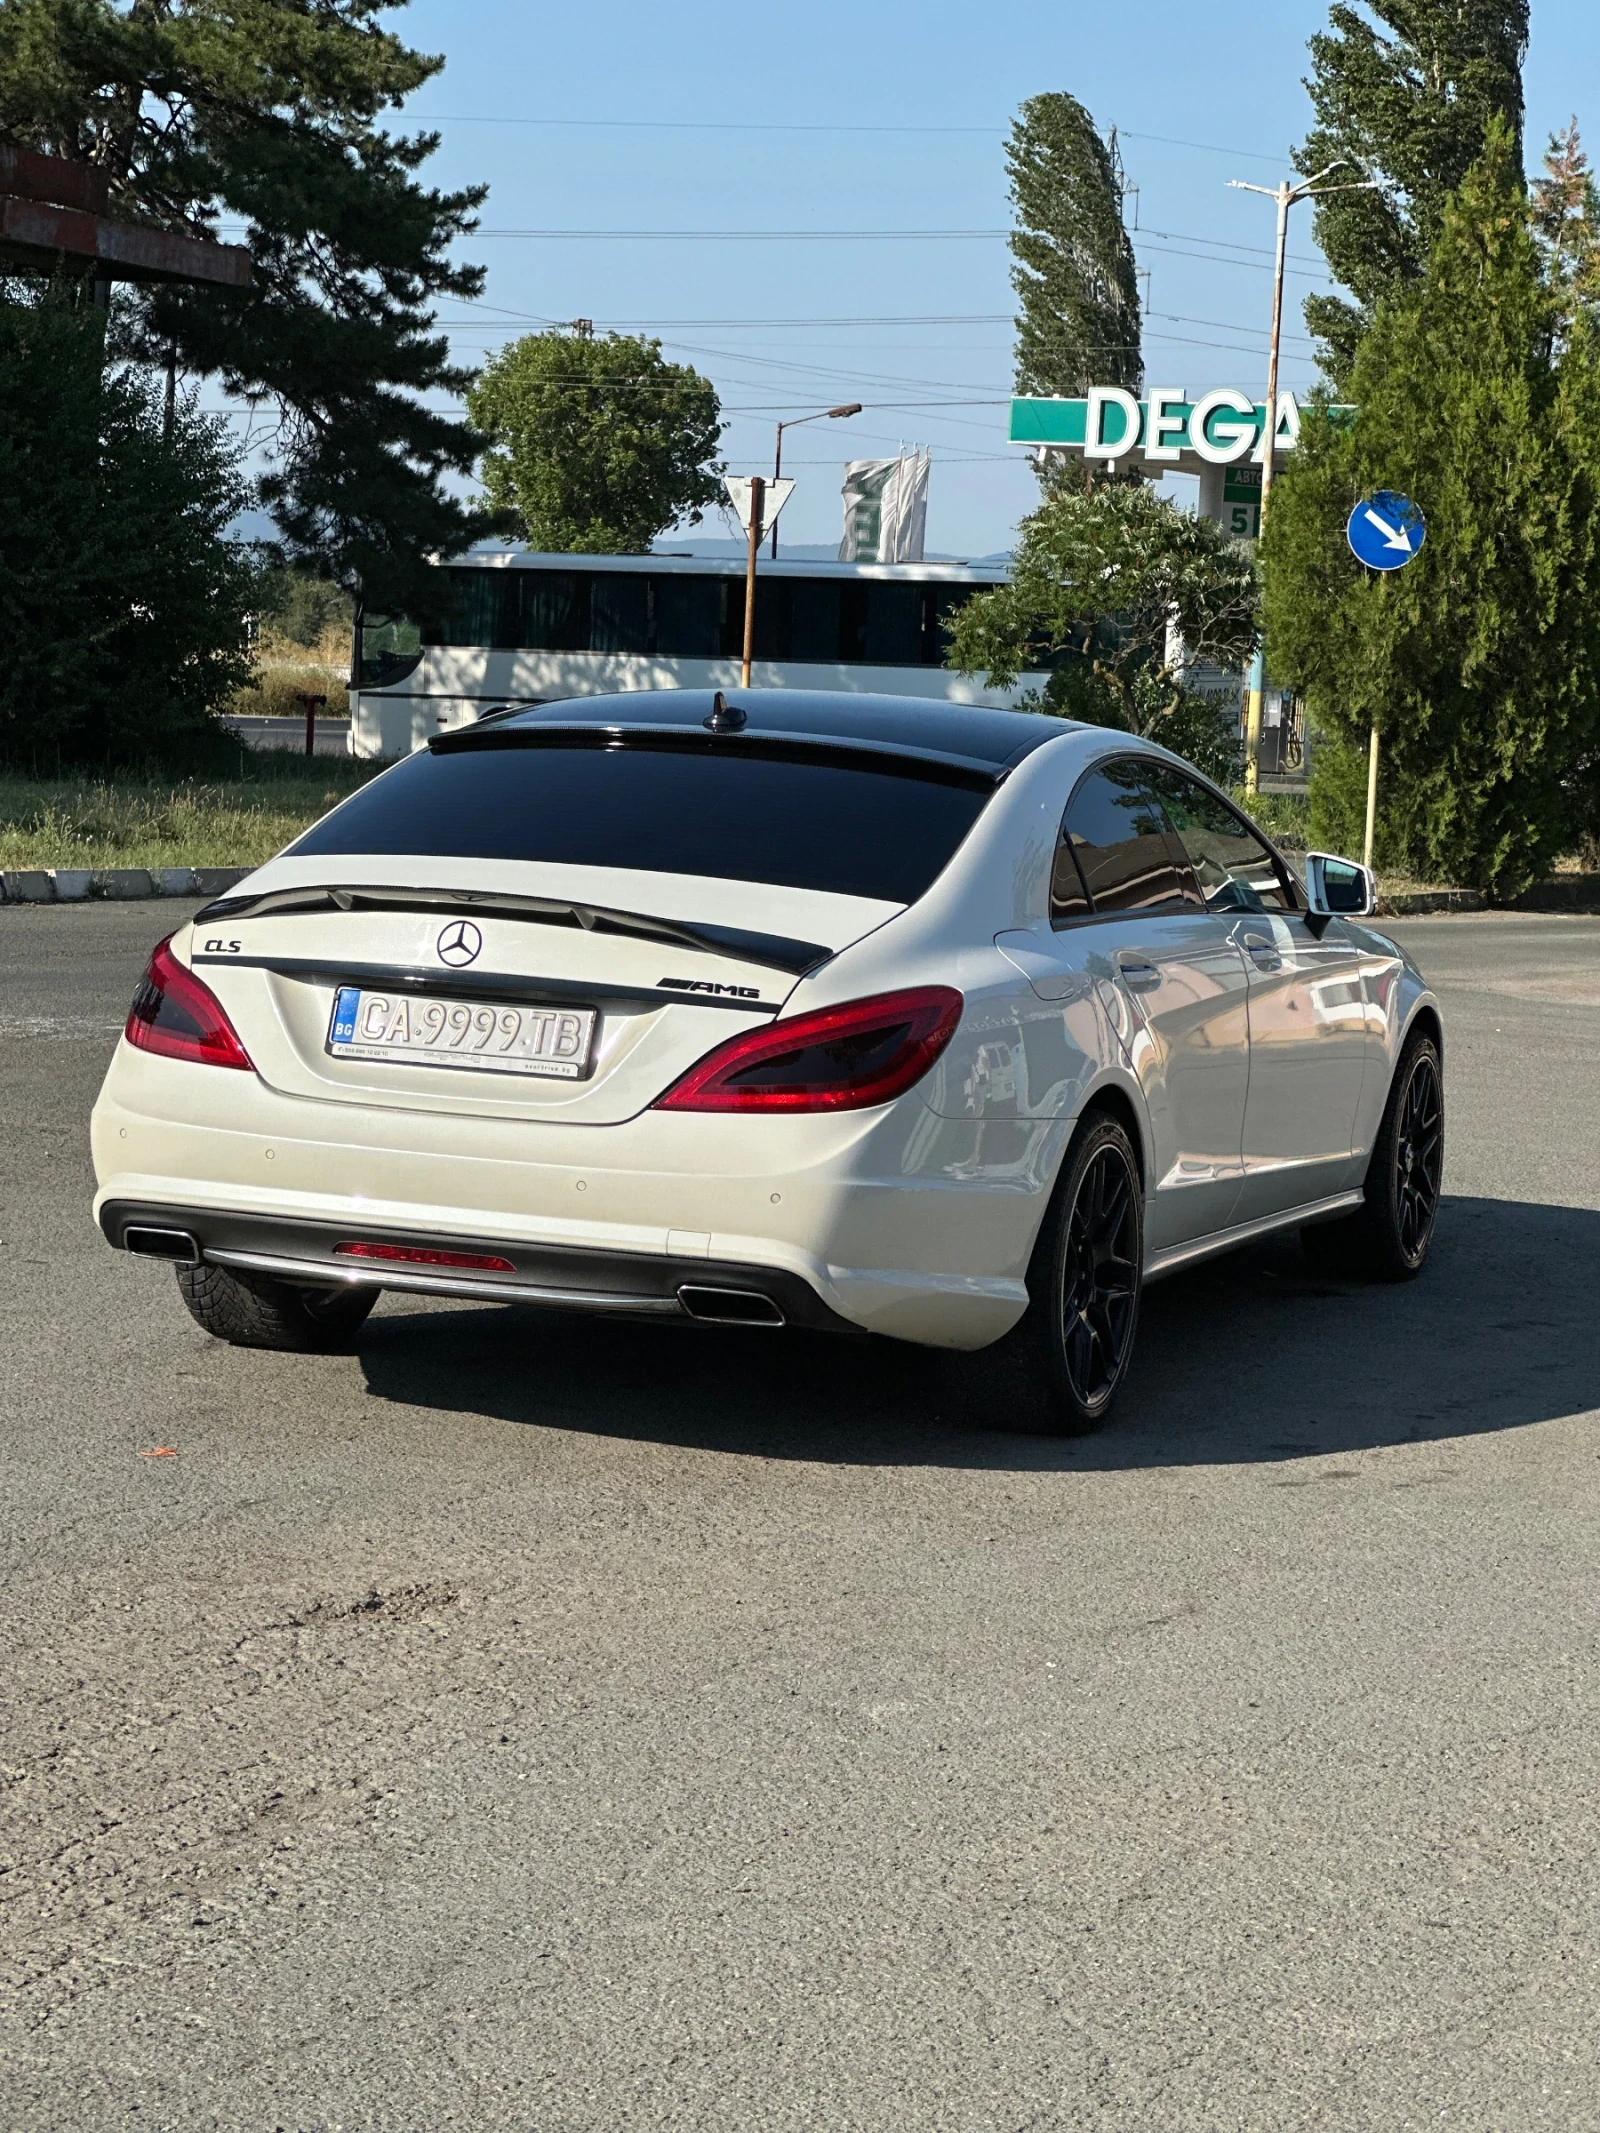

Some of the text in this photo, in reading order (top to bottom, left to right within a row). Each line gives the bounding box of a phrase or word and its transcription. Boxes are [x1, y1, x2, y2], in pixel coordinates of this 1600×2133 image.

[1084, 387, 1302, 463] DEGA
[204, 939, 242, 953] CLS
[690, 981, 760, 999] AMG
[335, 1023, 353, 1036] BG
[361, 997, 581, 1057] CA 9999 TB
